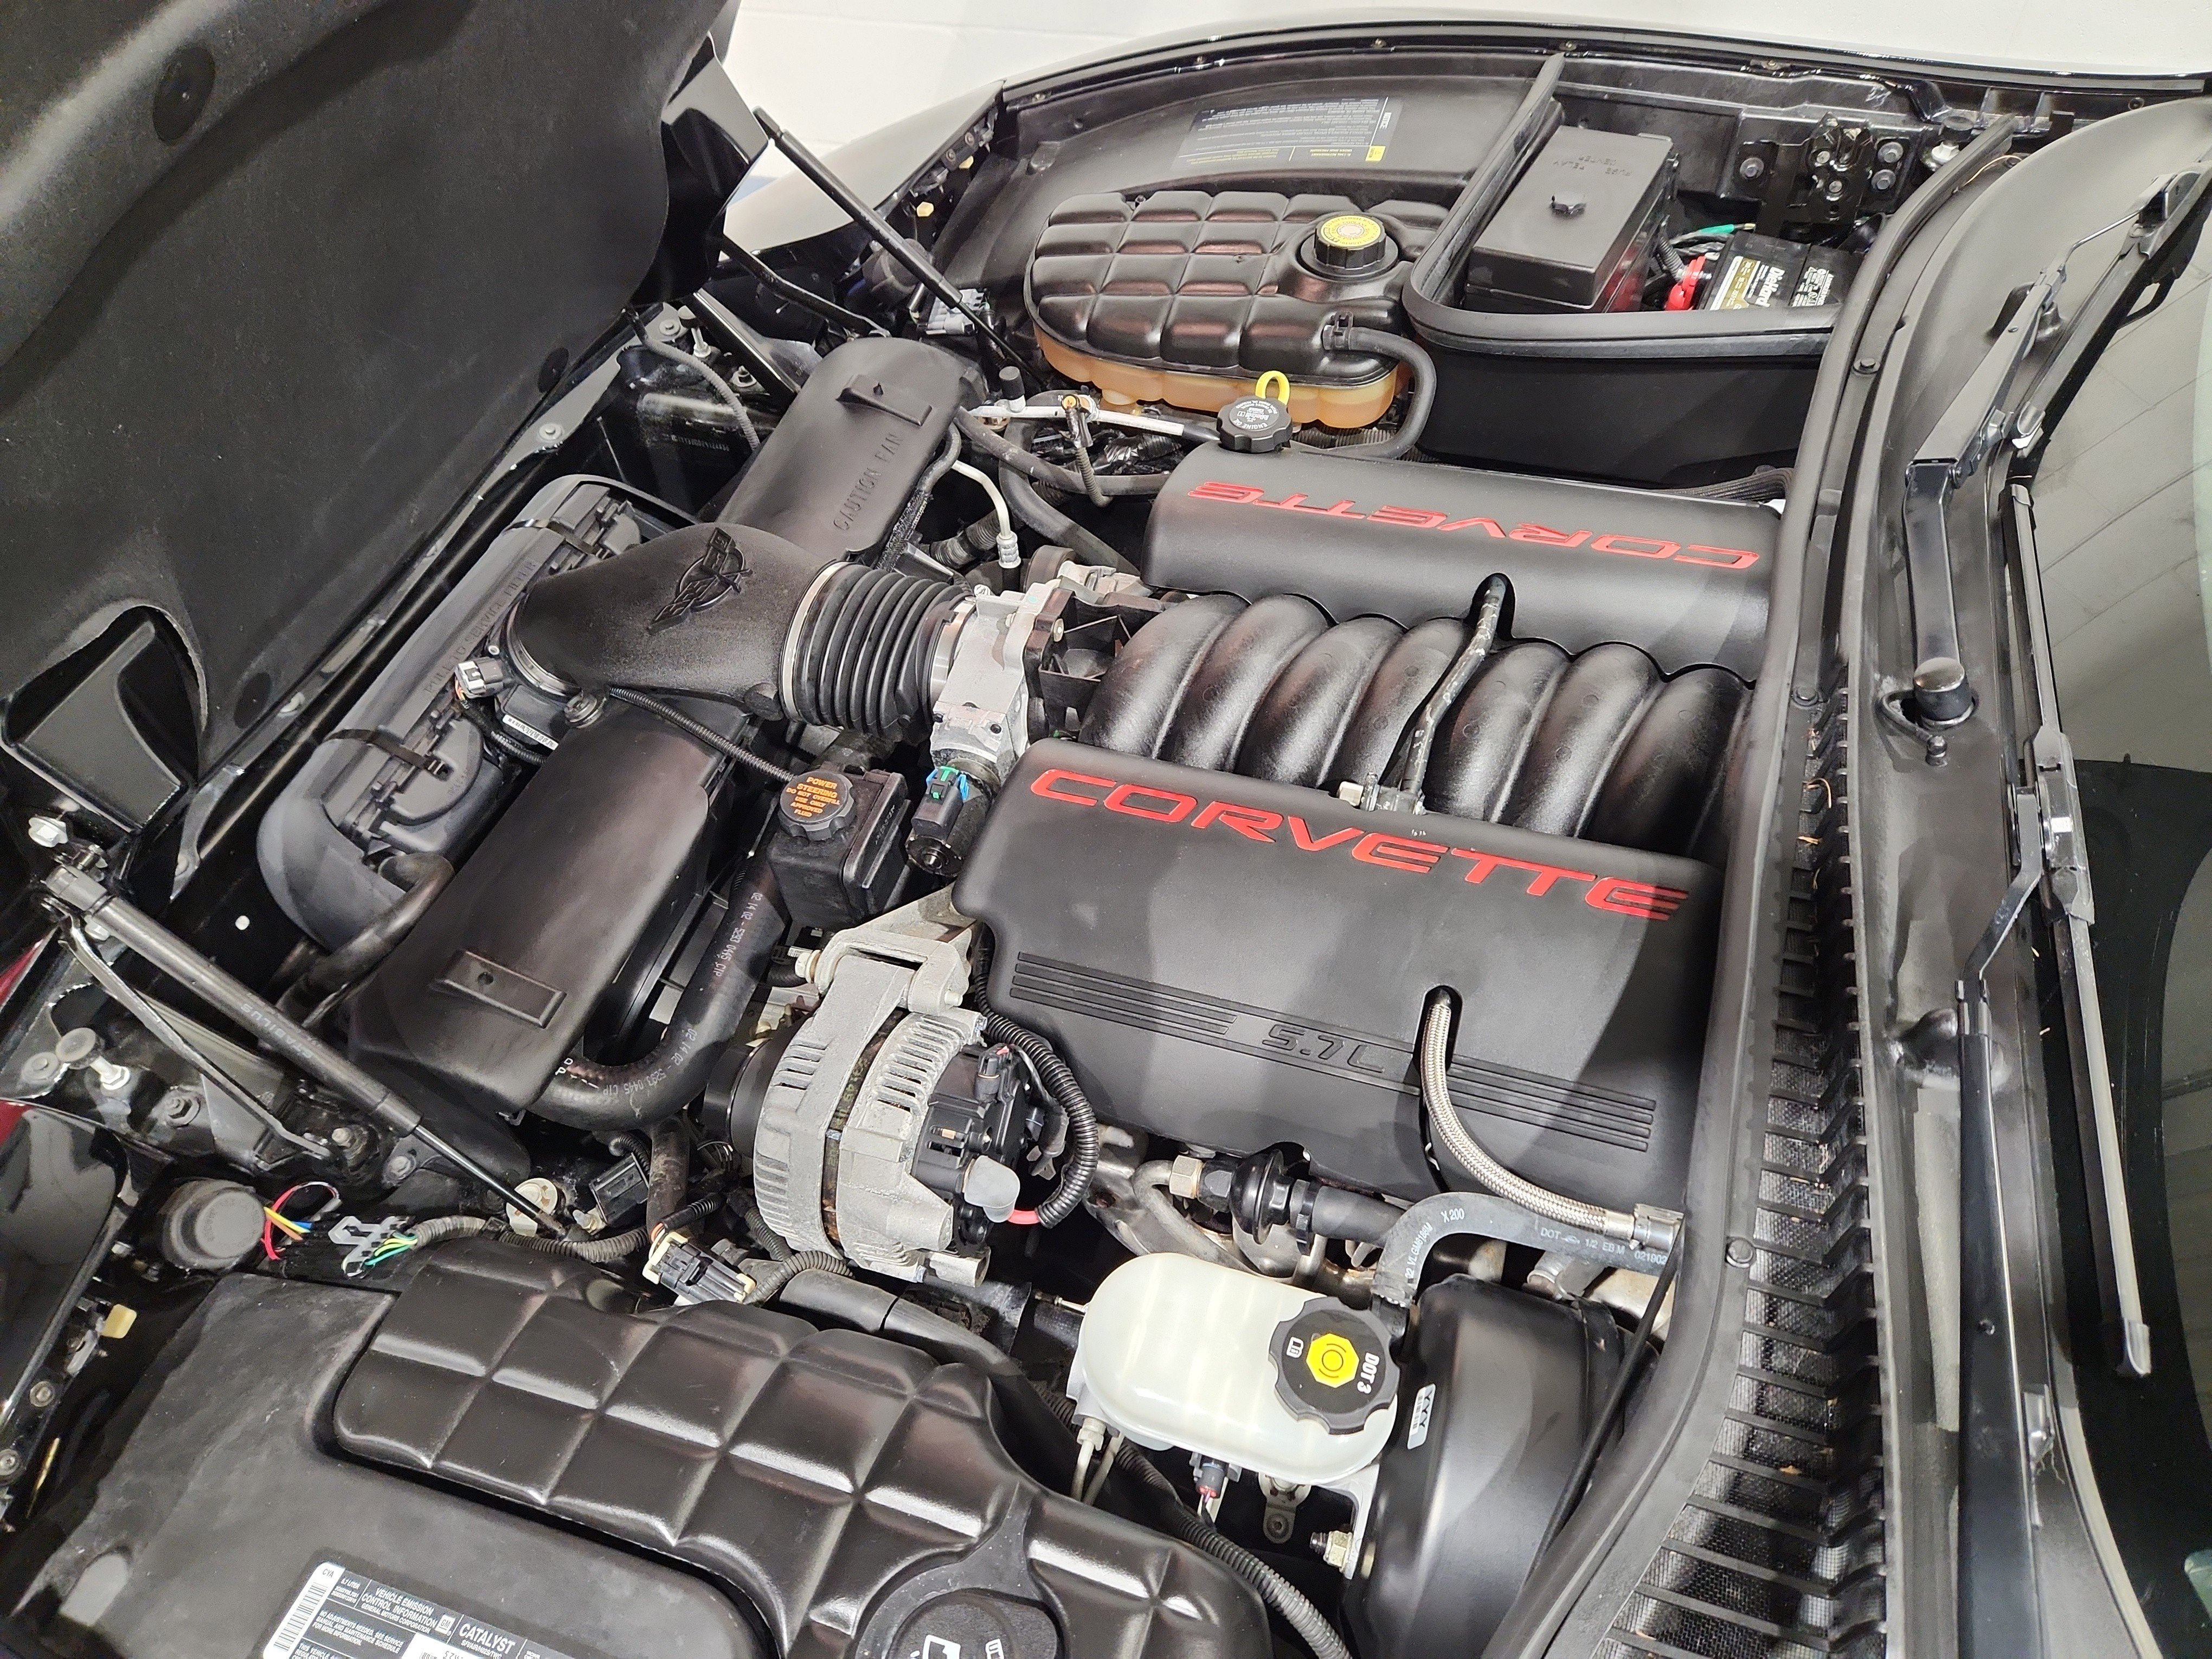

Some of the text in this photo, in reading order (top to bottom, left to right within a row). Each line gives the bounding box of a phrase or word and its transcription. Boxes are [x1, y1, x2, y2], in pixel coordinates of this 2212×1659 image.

[1755, 267, 1785, 307] DieHard
[834, 431, 903, 531] CAUTION FAN
[1188, 481, 1759, 570] CORVETTE
[424, 665, 451, 693] PULL
[465, 603, 503, 641] SERVICE
[806, 776, 838, 789] POWER
[796, 783, 838, 799] STEERING
[790, 802, 824, 813] APPROVED
[812, 794, 840, 805] OVERFILL
[794, 809, 813, 818] FLUID
[1031, 768, 1689, 922] CORVETTE
[751, 892, 763, 901] 02
[747, 902, 757, 910] 14
[741, 910, 753, 920] 02
[731, 928, 745, 943] 5293
[721, 944, 736, 961] 0445
[713, 962, 725, 976] CIP
[240, 1001, 314, 1059] STABILUS
[686, 1028, 698, 1041] 02
[680, 1045, 691, 1054] 14
[1262, 1023, 1384, 1074] 5.7L
[671, 1052, 683, 1065] 02
[647, 1069, 666, 1084] 5293
[603, 1085, 619, 1096] CIP
[624, 1078, 645, 1096] 0445
[1541, 1227, 1561, 1240] DOT
[1585, 1238, 1598, 1248] 1/2
[1602, 1243, 1615, 1252] EB
[1634, 1250, 1668, 1265] 021902
[1407, 1256, 1417, 1265] VL
[1357, 1352, 1380, 1394] DOT 3
[1419, 1390, 1432, 1427] YYY
[322, 1568, 335, 1578] CYA
[347, 1580, 361, 1590] LITER
[375, 1587, 434, 1616] VEHICLE EMISSION
[361, 1593, 438, 1629] CONTROL INFORMATION
[361, 1603, 432, 1634] GENERAL MOTORS CORPORATION
[326, 1612, 357, 1629] ADJUSTMENTS
[355, 1622, 374, 1635] NEEDED.
[374, 1631, 385, 1640] SEE
[383, 1634, 404, 1648] SERVICE
[440, 1618, 451, 1628] GM
[312, 1622, 363, 1647] FOR MORE INFORMATION.
[316, 1616, 401, 1654] MANUAL AND MAINTENANCE SCHEDULE
[459, 1623, 516, 1654] CATALYST
[299, 1643, 310, 1652] THIS
[310, 1647, 331, 1659] VEHICLE
